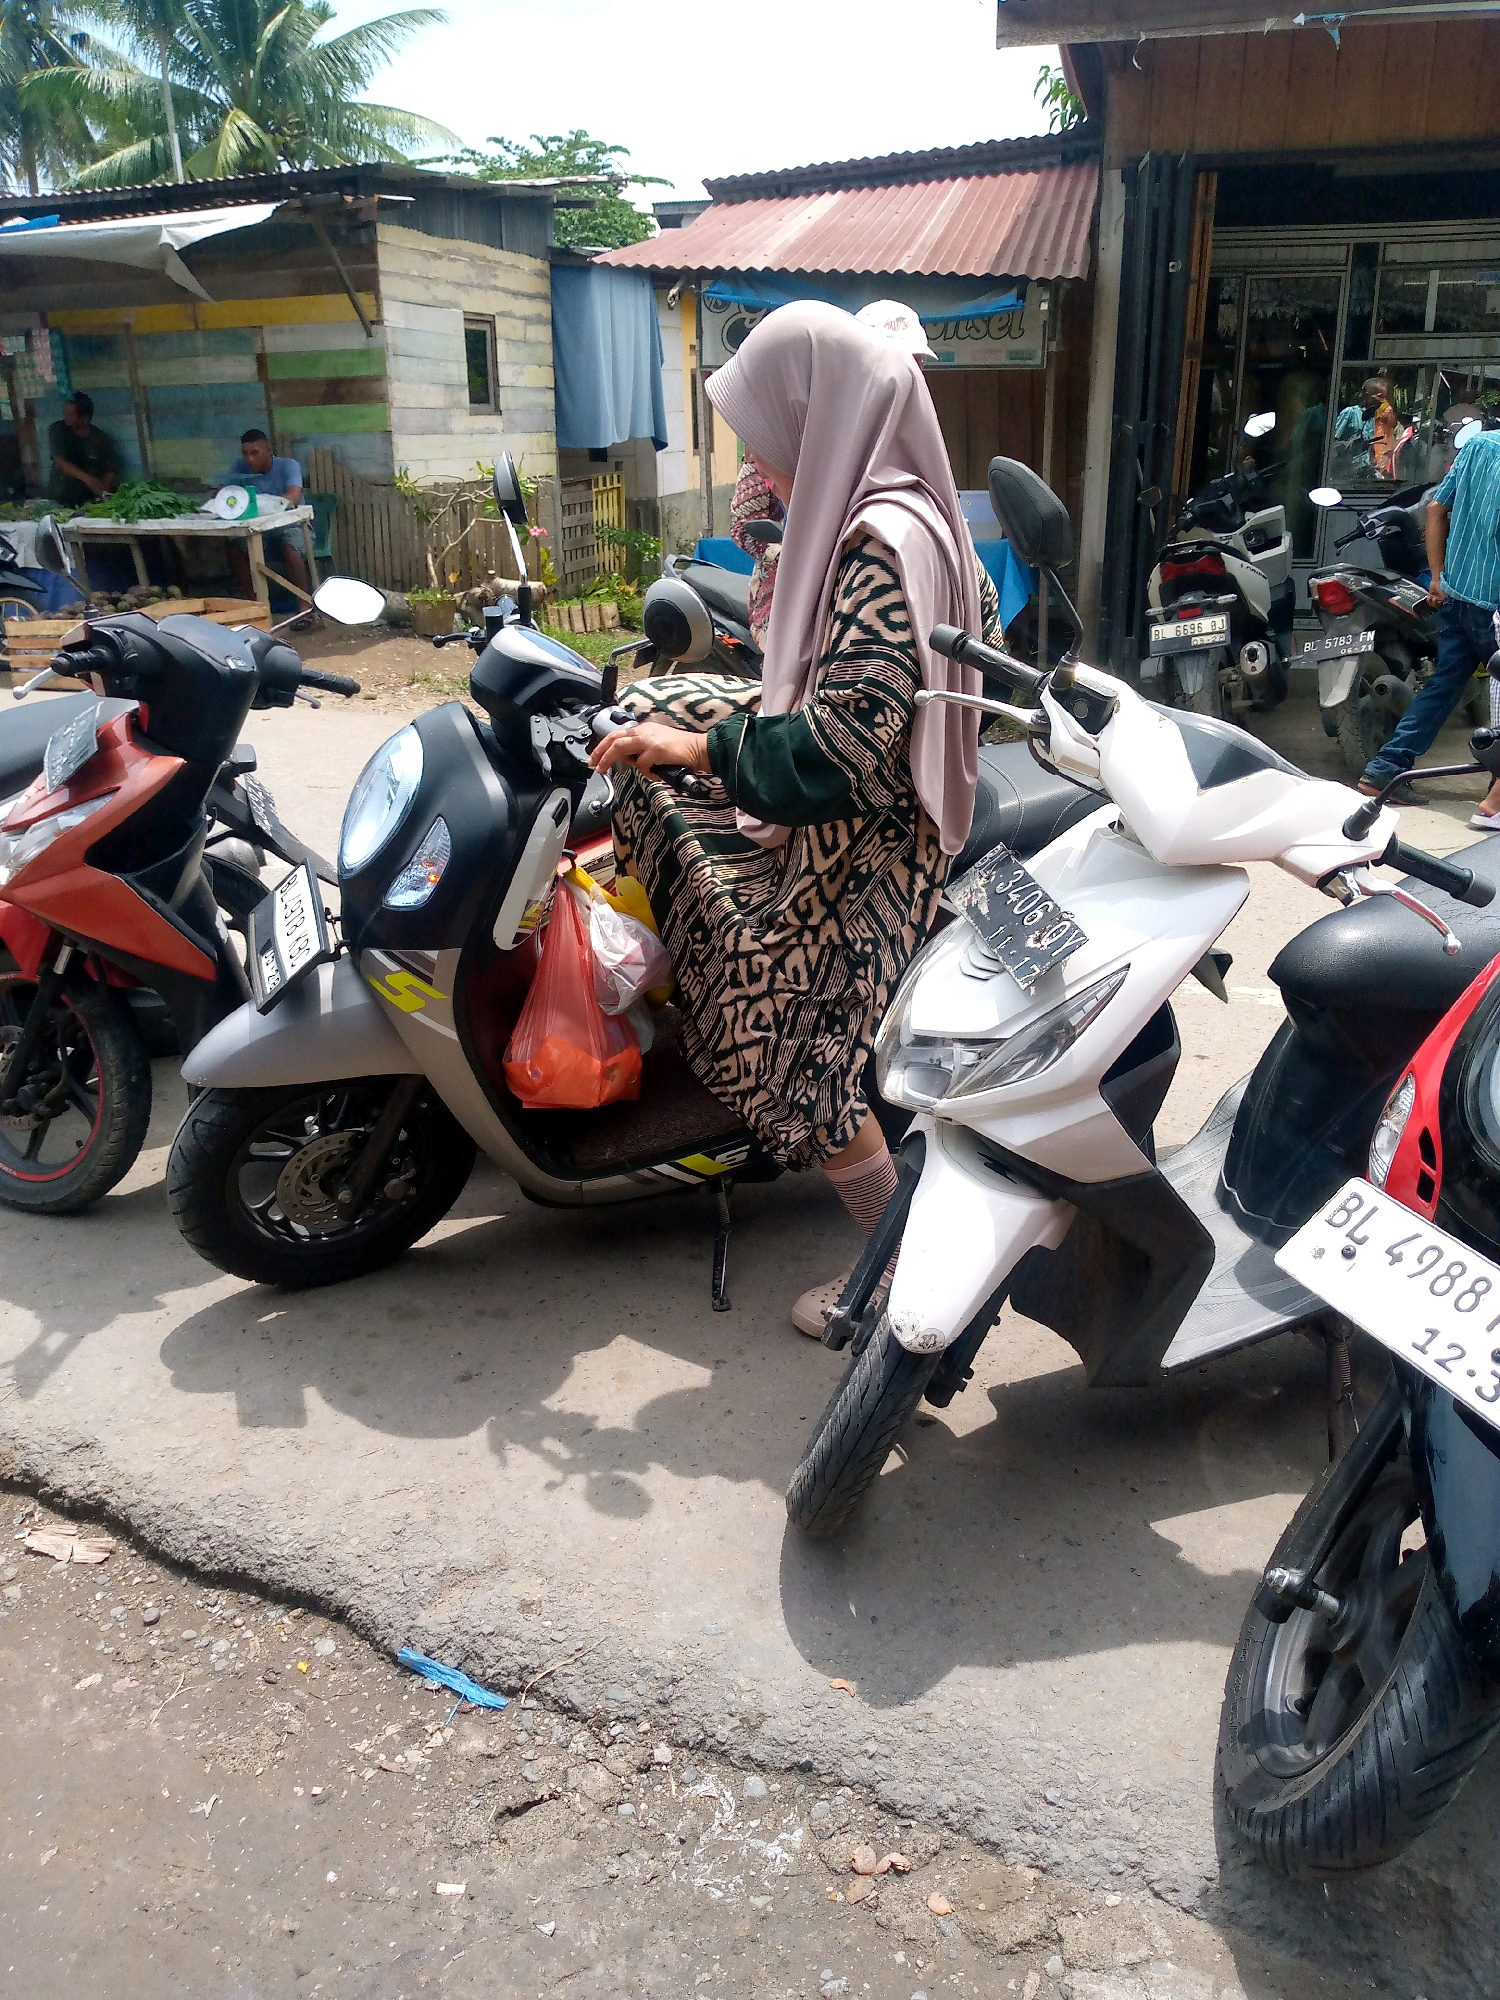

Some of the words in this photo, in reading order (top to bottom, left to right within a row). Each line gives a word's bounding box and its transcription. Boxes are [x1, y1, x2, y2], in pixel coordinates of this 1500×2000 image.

[1154, 629, 1166, 640] BL
[1175, 622, 1203, 637] 6696
[1303, 641, 1318, 653] BL
[1324, 634, 1353, 649] 5783
[1359, 630, 1376, 643] FN
[280, 874, 299, 903] BL
[995, 869, 1054, 926] 3406
[284, 893, 306, 937] 4978
[1325, 1191, 1379, 1245] BL
[1385, 1232, 1493, 1313] 4988
